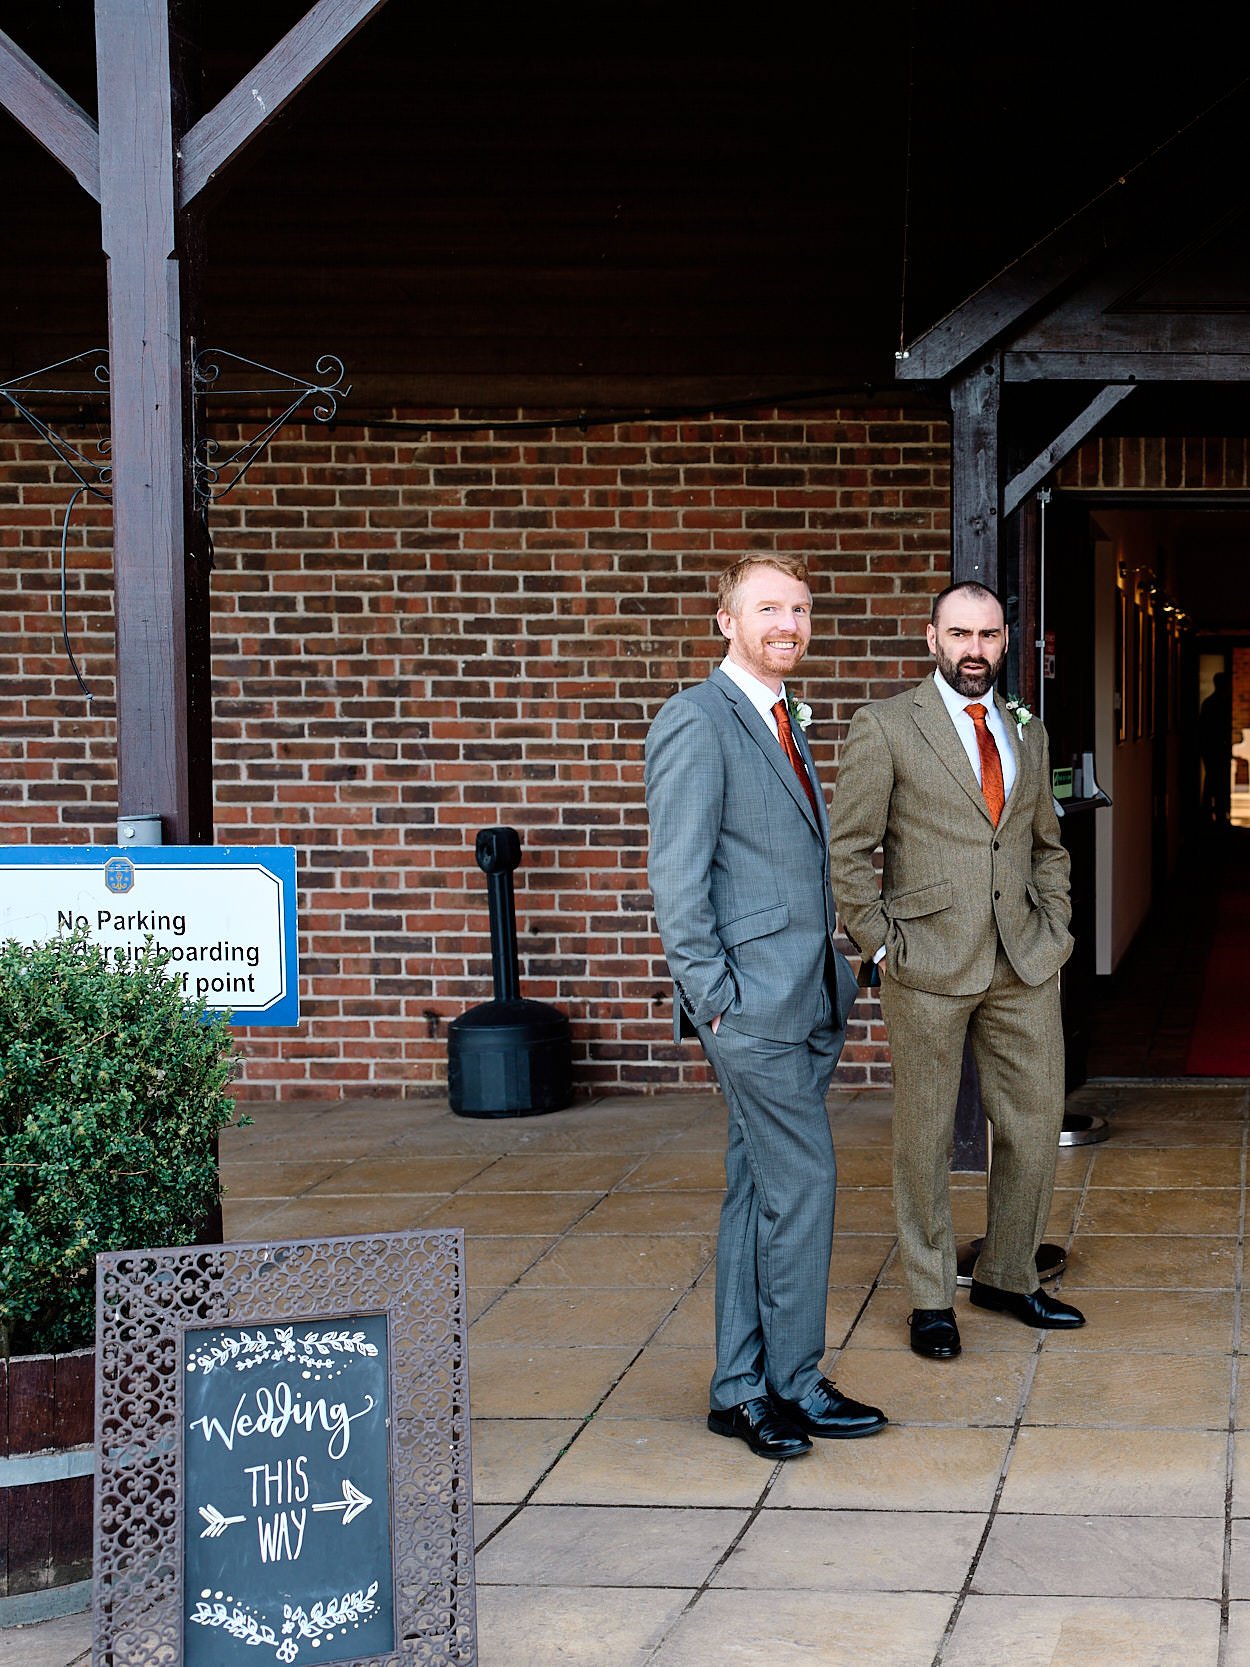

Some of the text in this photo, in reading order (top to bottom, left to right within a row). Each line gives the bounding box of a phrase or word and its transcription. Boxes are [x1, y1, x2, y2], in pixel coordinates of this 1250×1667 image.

[57, 910, 185, 935] No Parking
[95, 941, 146, 961] rain
[156, 941, 259, 967] boarding
[160, 971, 255, 998] of point
[190, 1382, 374, 1460] Wedding
[244, 1456, 309, 1507] THIS
[258, 1508, 307, 1563] WAY
